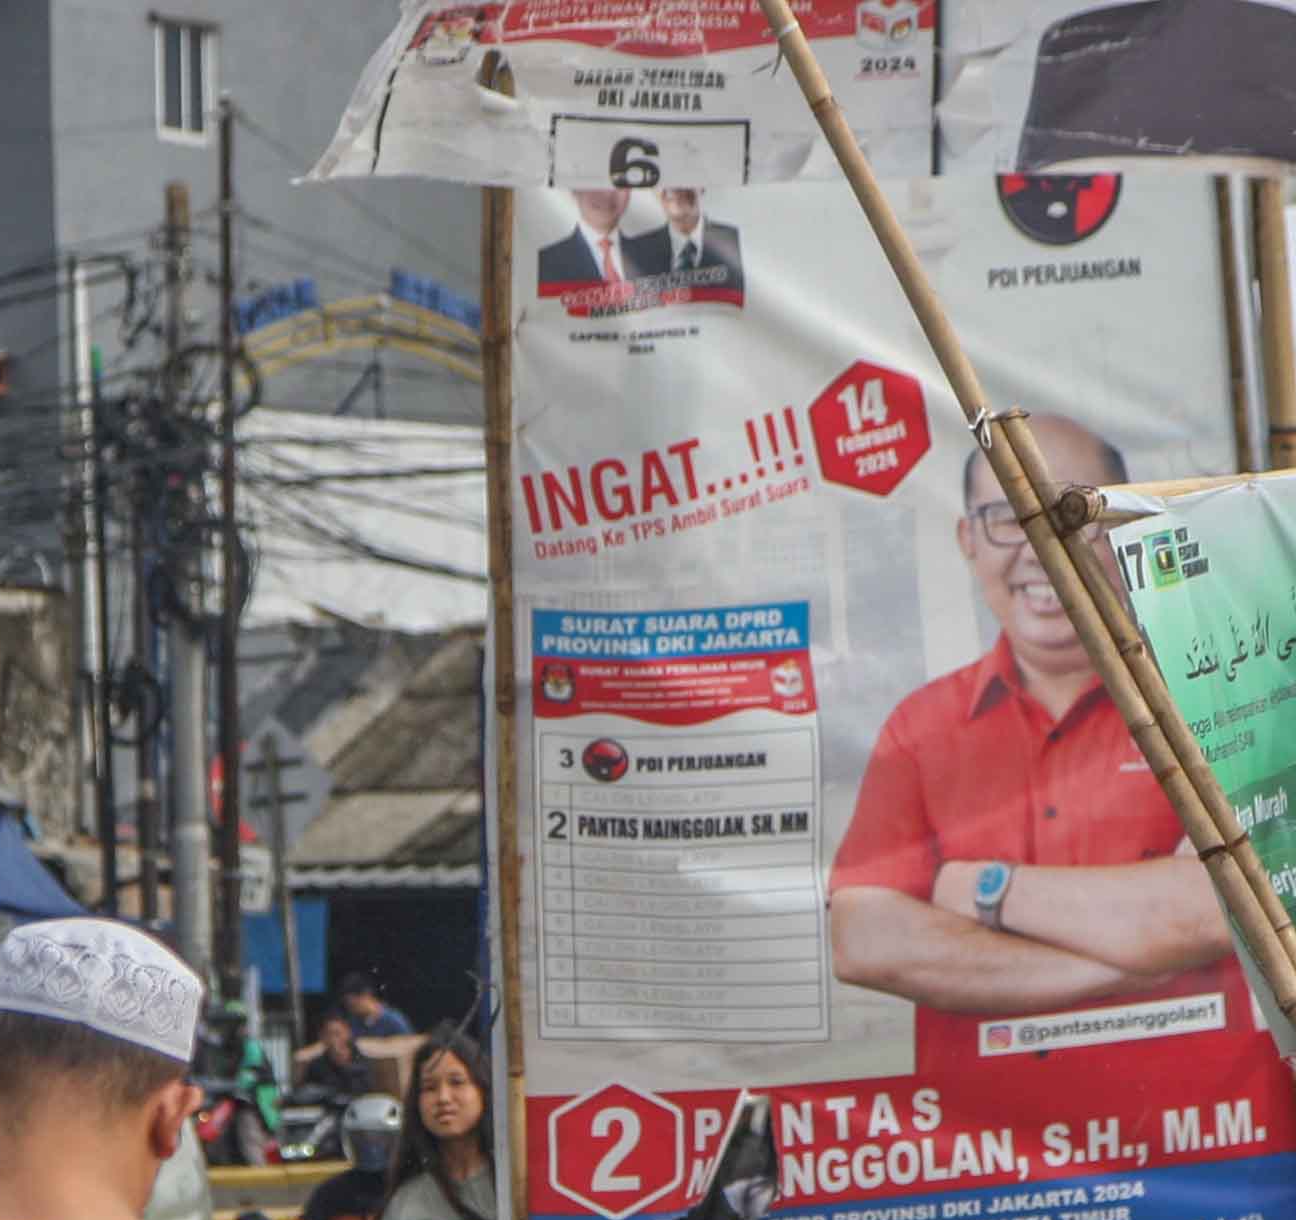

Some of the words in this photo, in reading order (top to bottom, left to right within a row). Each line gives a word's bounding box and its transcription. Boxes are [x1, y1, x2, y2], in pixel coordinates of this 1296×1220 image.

[860, 56, 917, 73] 2024
[609, 136, 661, 188] 6
[988, 267, 1018, 288] PDI
[1022, 257, 1142, 286] PERJUANGAN
[837, 378, 889, 432] 14
[854, 453, 899, 478] 2024
[534, 531, 599, 560] Datang
[601, 526, 626, 548] Ke
[630, 519, 667, 543] TPS
[670, 504, 719, 534] Ambil
[720, 490, 763, 519] Surat
[766, 474, 812, 505] Suara
[1116, 541, 1146, 592] 17
[542, 634, 649, 655] PROVINSI
[654, 633, 694, 652] DKI
[700, 627, 800, 651] JAKARTA
[560, 615, 637, 636] SURAT
[643, 612, 720, 634] SUARA
[725, 608, 783, 630] DPRD
[559, 748, 575, 769] 3
[635, 755, 664, 773] PDI
[667, 751, 767, 772] PERJUANGAN
[547, 810, 568, 840] 2
[577, 813, 640, 839] PANTAS
[779, 810, 810, 833] MM
[693, 1088, 943, 1152] PNTAS
[1042, 1117, 1149, 1167] S.H.,
[1162, 1098, 1268, 1155] M.M.
[590, 1106, 642, 1193] 2
[942, 1199, 982, 1219] DKI
[986, 1188, 1089, 1215] JAKARTA
[1092, 1180, 1146, 1204] 2024
